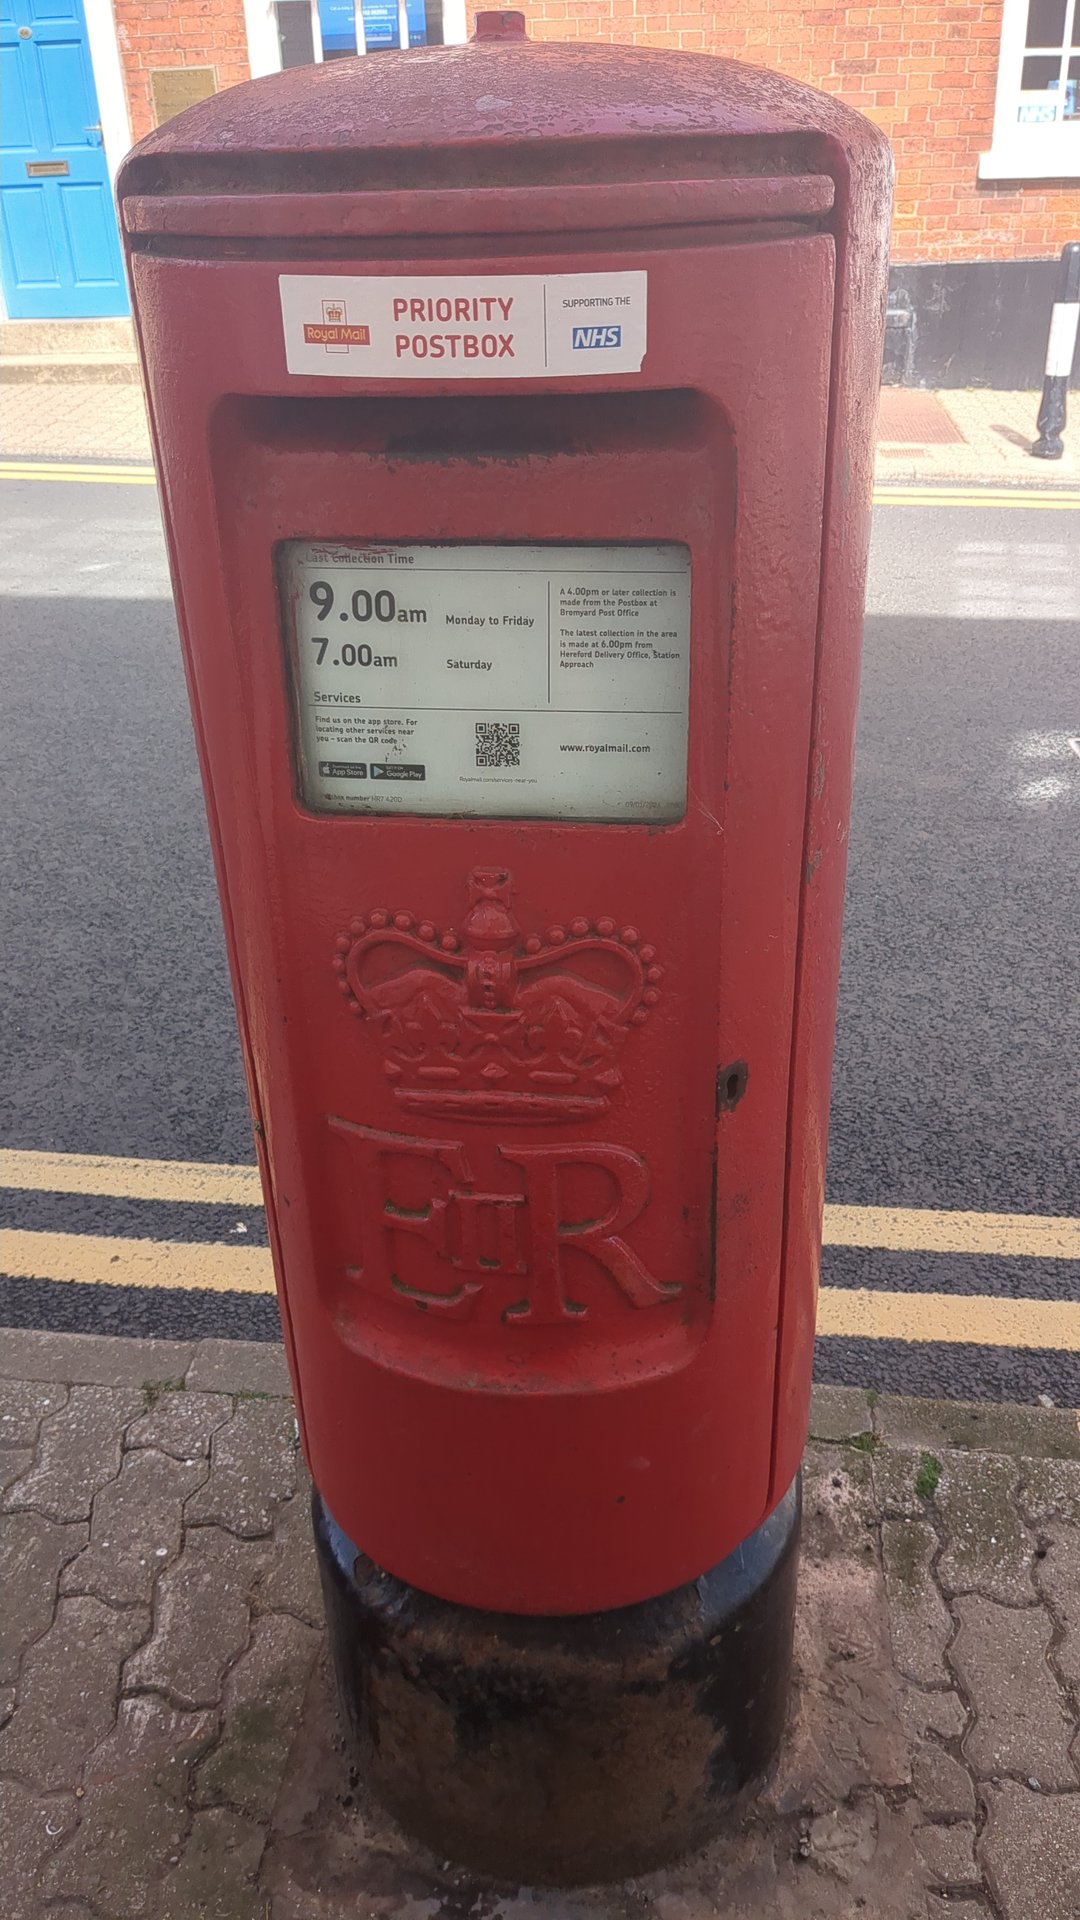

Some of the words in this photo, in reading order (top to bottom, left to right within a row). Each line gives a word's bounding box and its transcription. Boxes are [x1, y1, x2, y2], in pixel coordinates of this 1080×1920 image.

[562, 297, 614, 309] SUPPORTING
[615, 296, 631, 306] THE
[393, 296, 515, 322] PRIORITY
[307, 326, 338, 342] Royal
[340, 326, 366, 340] Mail
[574, 326, 619, 348] NHS
[395, 333, 515, 358] POSTBOX
[388, 553, 414, 564] Time
[567, 588, 599, 597] 4.00pm
[309, 581, 427, 623] 9.00am
[560, 609, 596, 617] Bromyard
[445, 615, 485, 627] Monday
[489, 616, 499, 625] to
[502, 616, 534, 627] Friday
[601, 641, 632, 650] 6.00pm
[311, 637, 398, 667] 7.00am
[595, 651, 624, 660] Delivery
[627, 652, 650, 660] Office,
[653, 650, 680, 658] Station
[446, 659, 492, 671] Saturday
[314, 692, 361, 703] Services
[368, 719, 381, 727] app
[316, 726, 343, 734] locating
[560, 743, 651, 754] www.royalmail.com
